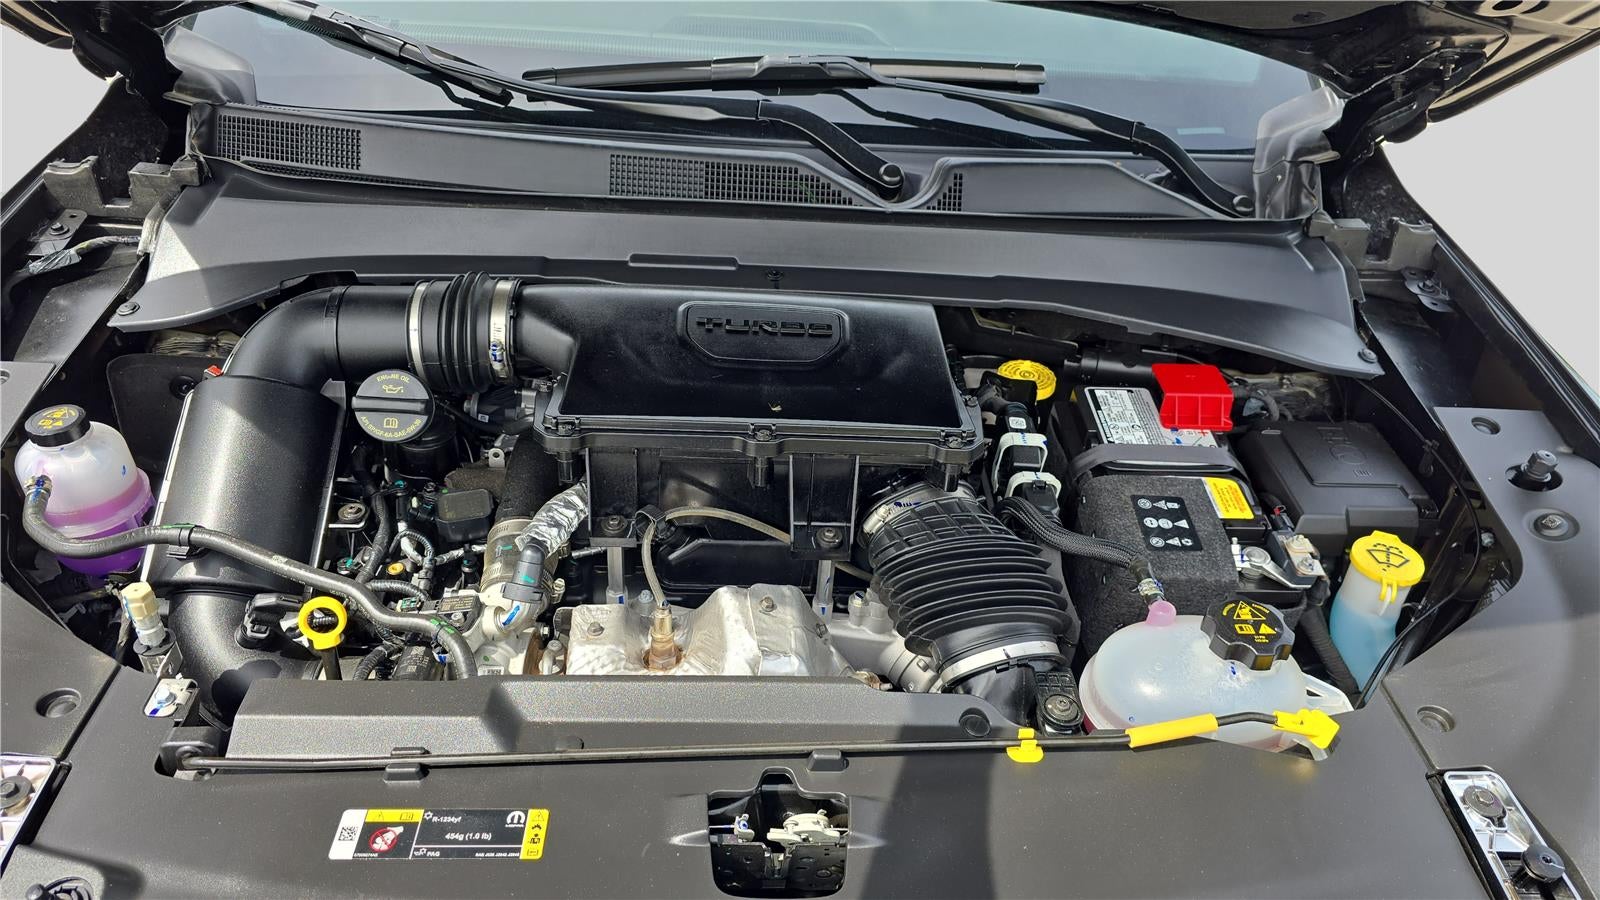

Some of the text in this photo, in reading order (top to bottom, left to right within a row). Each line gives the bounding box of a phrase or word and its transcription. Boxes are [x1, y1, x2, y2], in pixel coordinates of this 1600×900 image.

[696, 316, 833, 337] TURBO
[432, 816, 462, 824] R-1234yf
[445, 832, 492, 841] 454g (1.0 lb)
